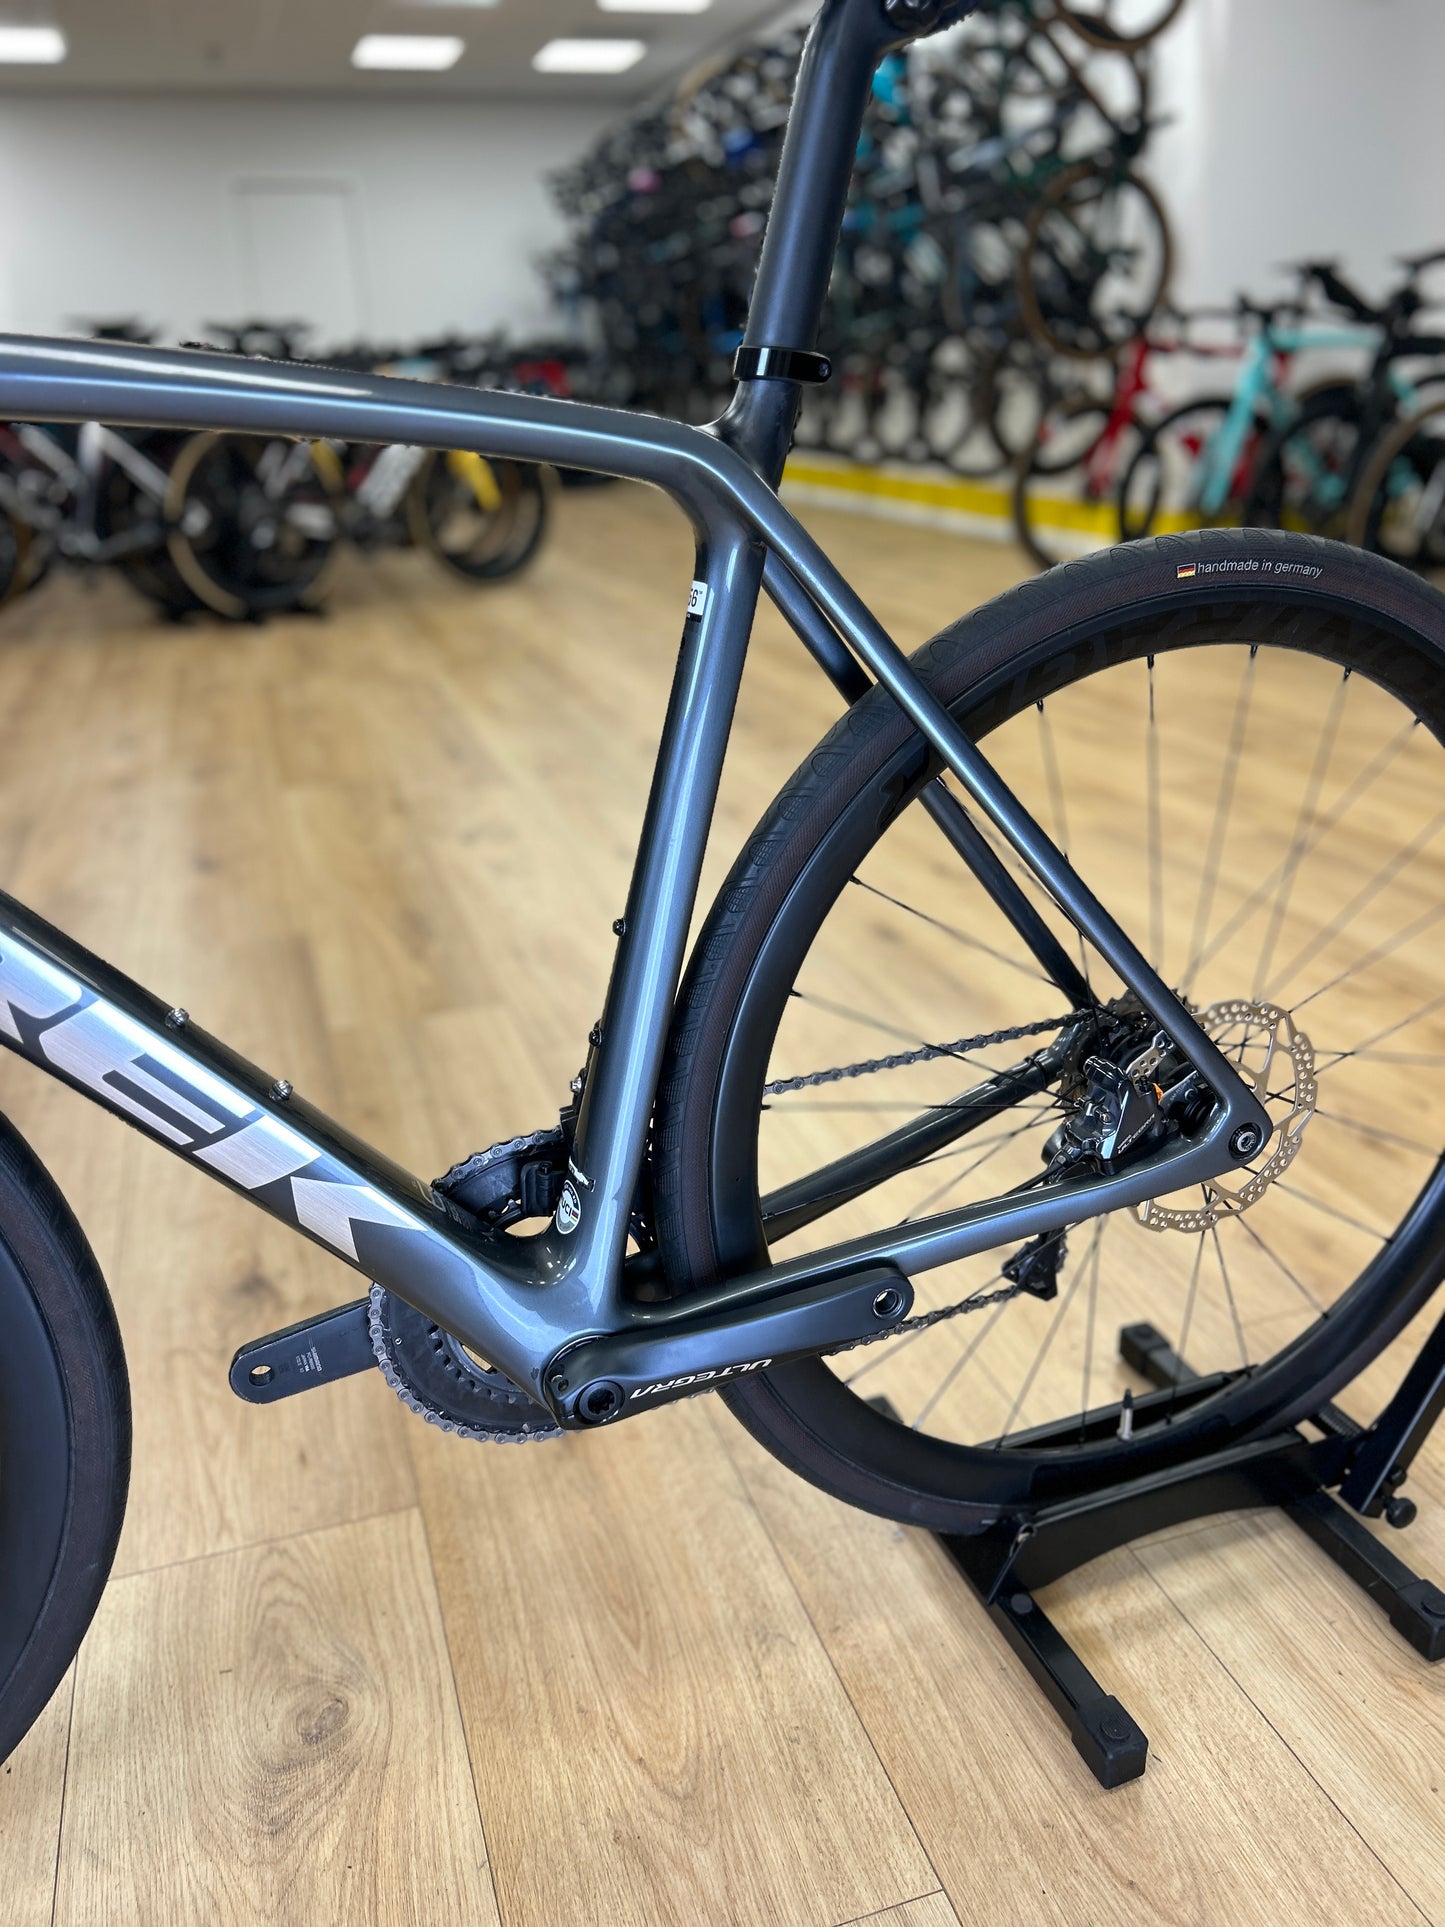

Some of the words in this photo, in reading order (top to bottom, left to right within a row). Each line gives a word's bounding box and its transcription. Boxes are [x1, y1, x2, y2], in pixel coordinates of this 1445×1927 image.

[1197, 560, 1259, 573] handmade
[1261, 559, 1272, 571] in
[1275, 562, 1322, 578] germany
[629, 1358, 772, 1400] ULTEGRA
